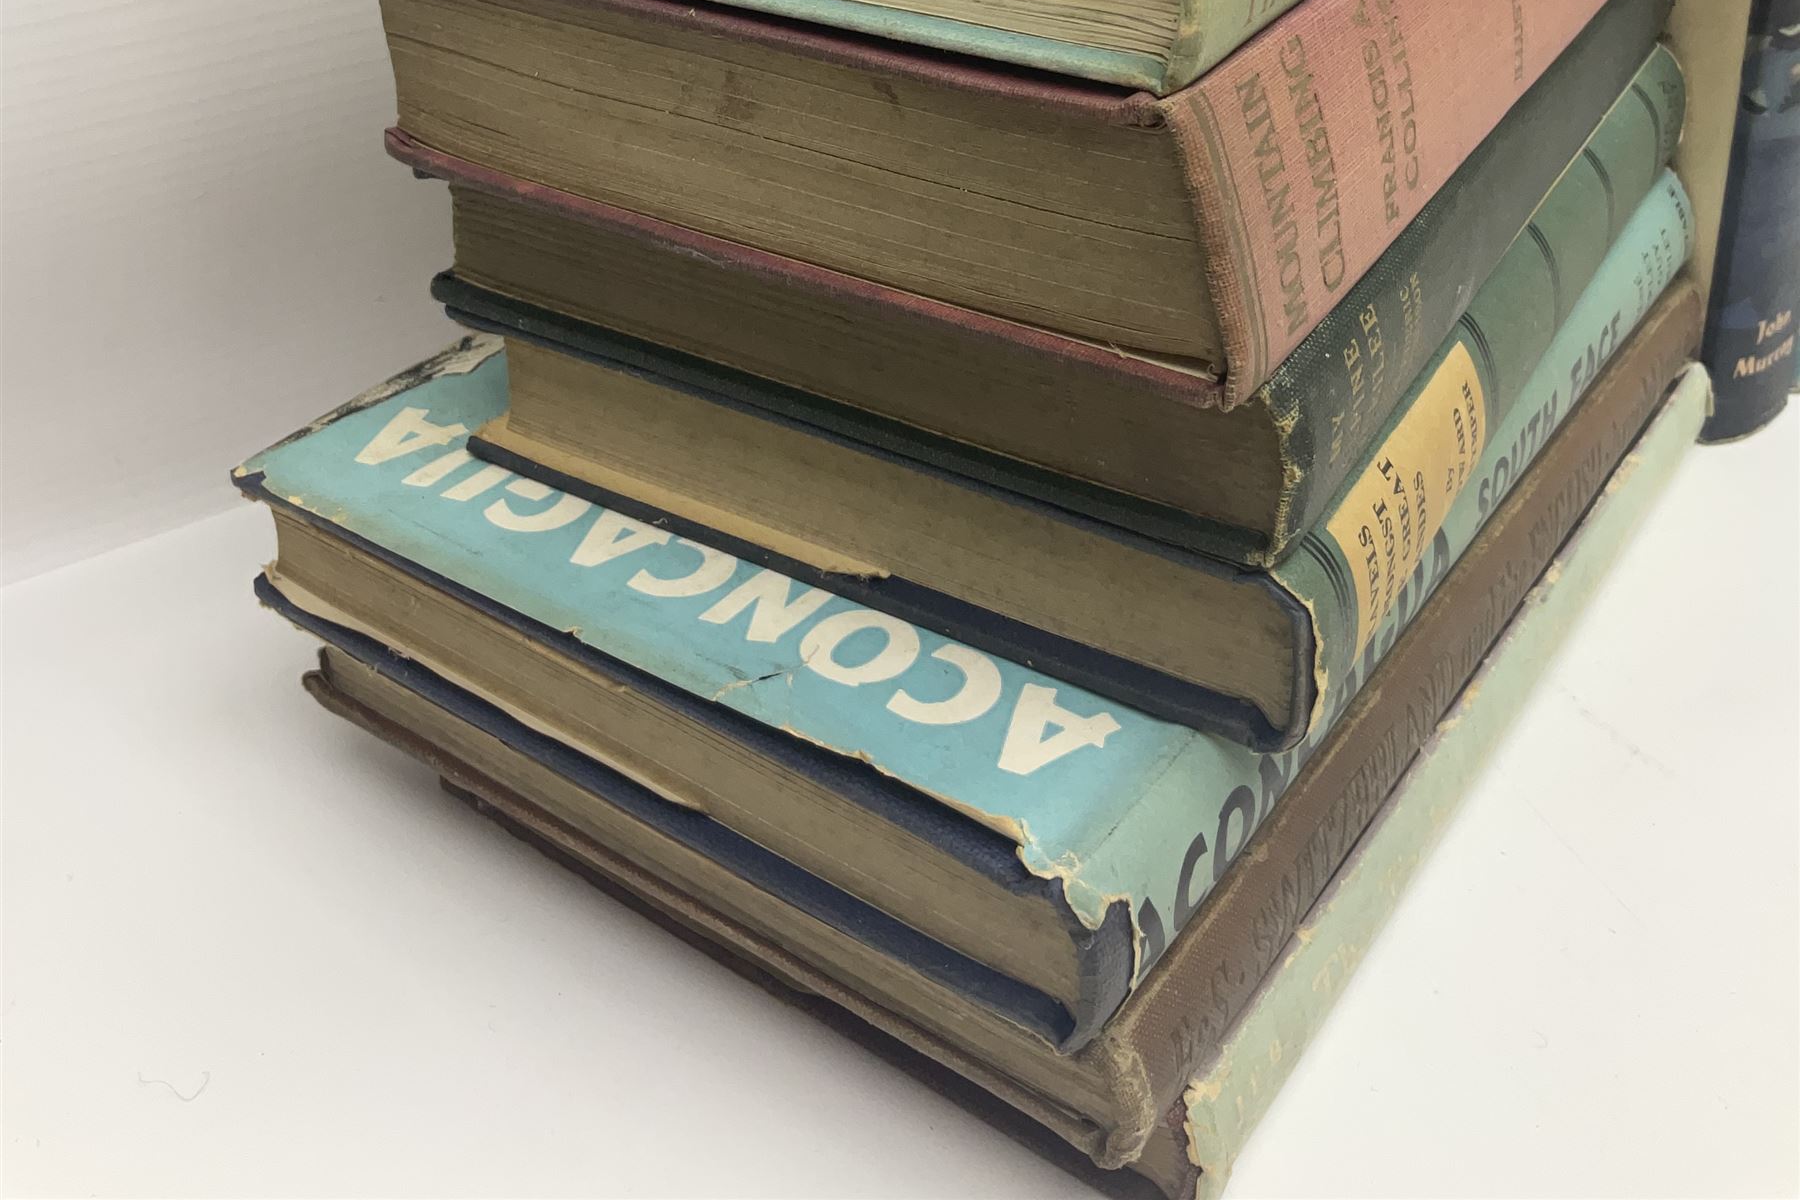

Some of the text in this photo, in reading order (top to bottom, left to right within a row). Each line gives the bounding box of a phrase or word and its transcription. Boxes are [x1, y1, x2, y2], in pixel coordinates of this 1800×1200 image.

[1234, 71, 1308, 337] MOUNTAIN
[1279, 33, 1346, 294] CLIMBING
[1364, 38, 1400, 230] FRANCIS
[1474, 389, 1558, 533] SOUTH
[1567, 309, 1621, 408] FACE
[1733, 335, 1795, 380] Murray
[1755, 309, 1793, 346] John
[353, 405, 1123, 776] ACONCAGUA
[1358, 524, 1381, 638] AVELS
[1376, 456, 1412, 562] GREAT
